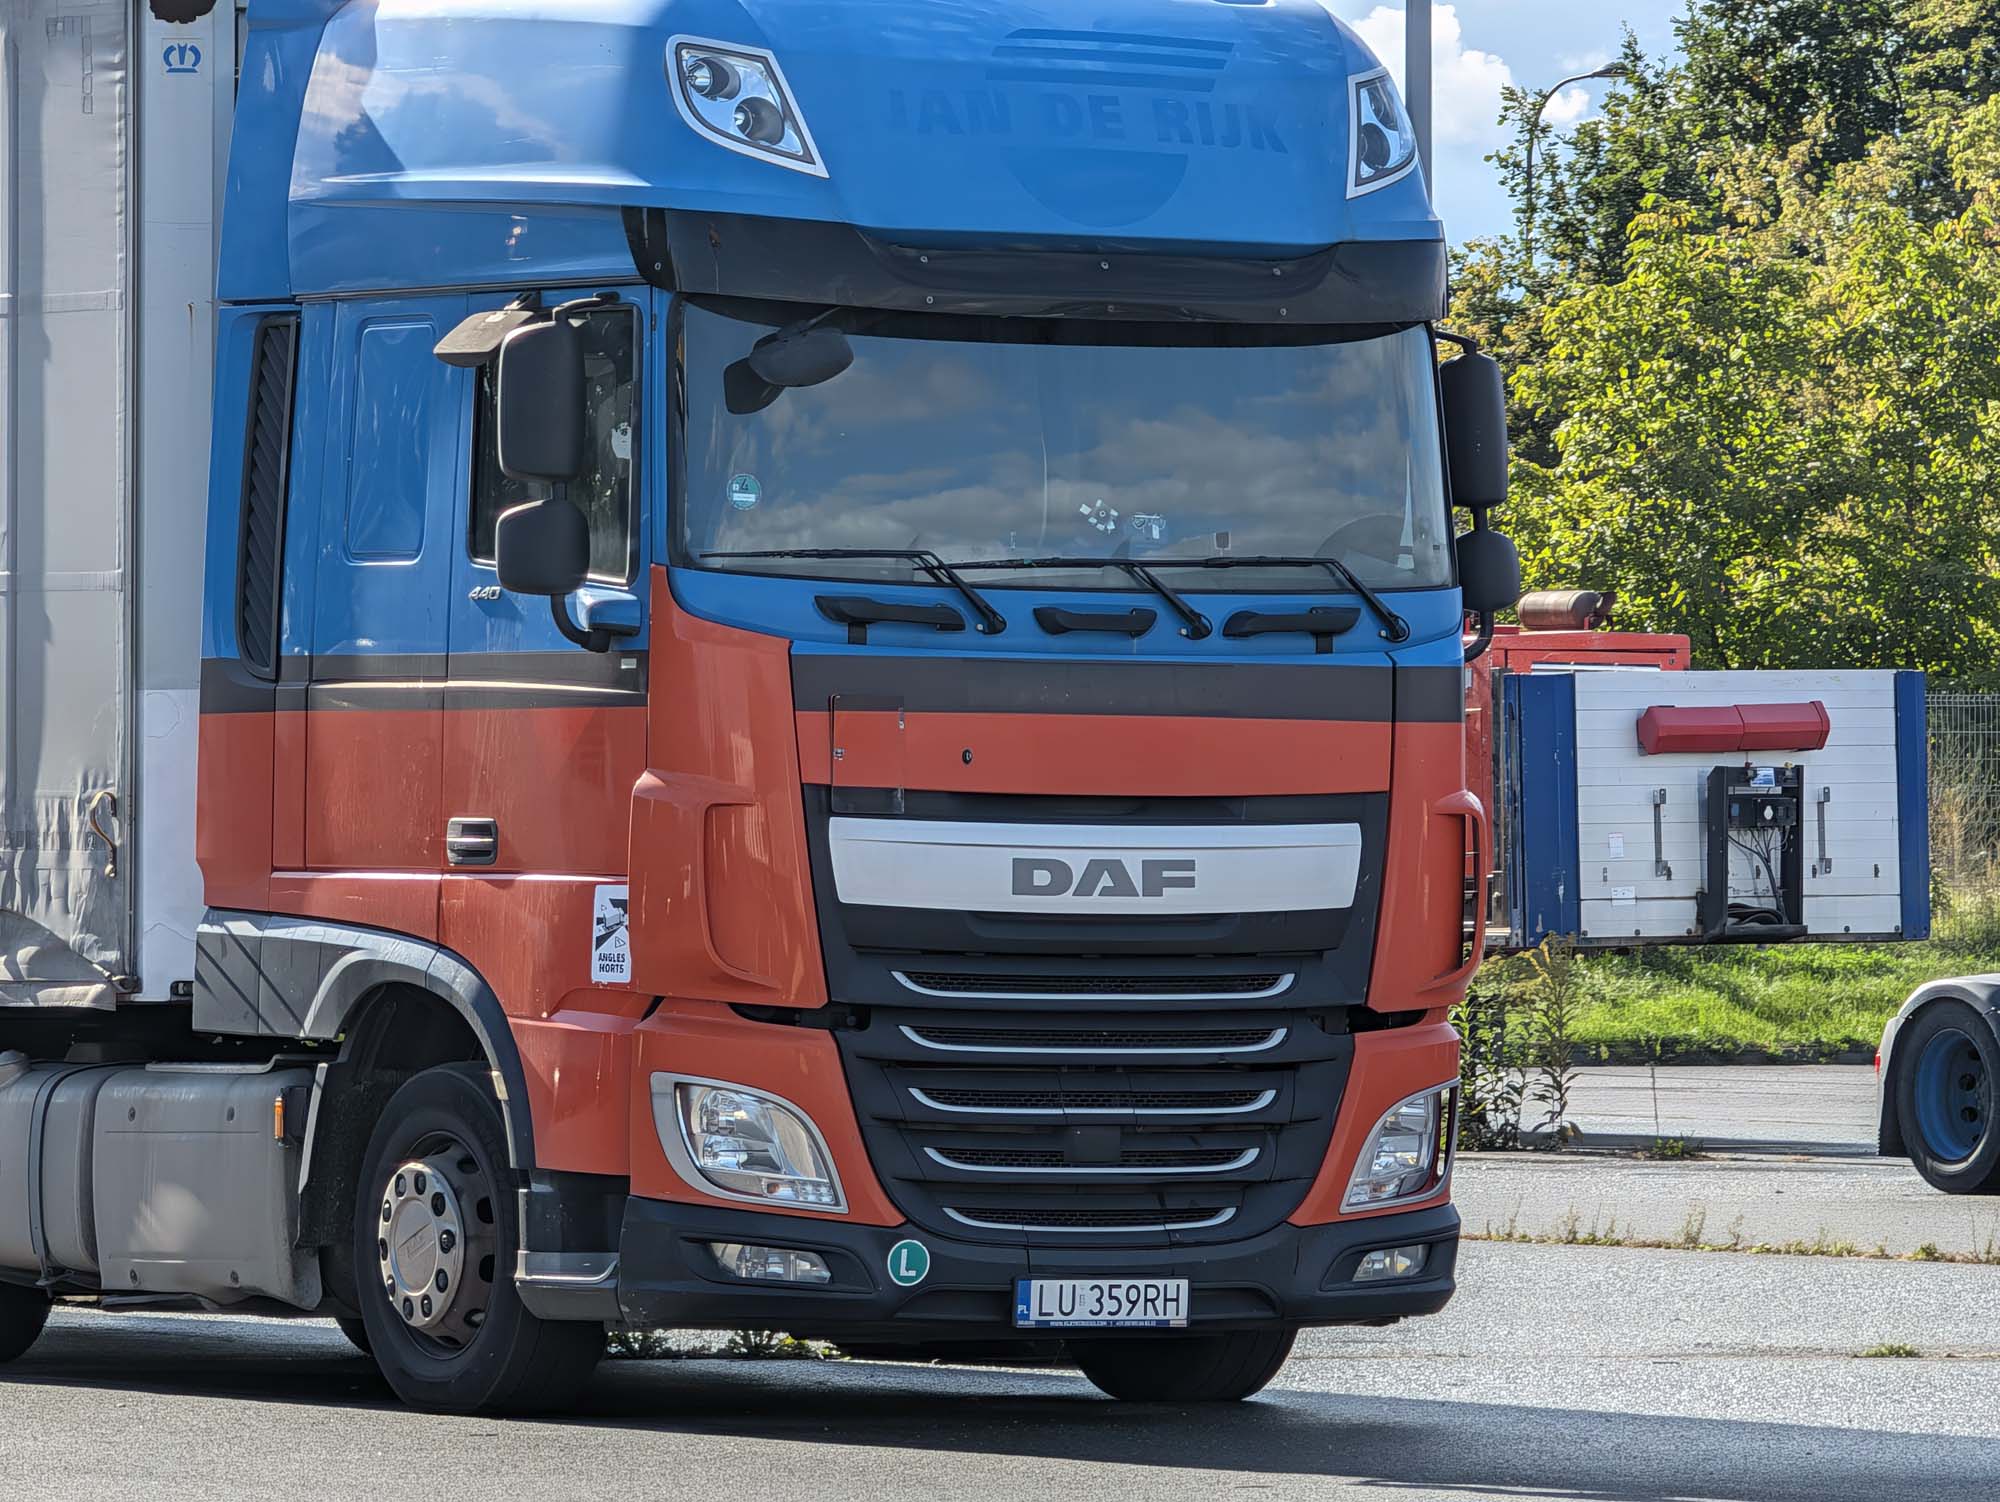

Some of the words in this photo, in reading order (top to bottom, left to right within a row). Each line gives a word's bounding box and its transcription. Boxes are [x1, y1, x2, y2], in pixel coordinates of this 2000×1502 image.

[1042, 92, 1127, 141] DE
[1151, 98, 1289, 154] RIJK
[468, 585, 501, 600] 440
[1012, 857, 1196, 897] DAF
[598, 953, 626, 963] ANGLES
[900, 1248, 917, 1277] L
[1017, 1304, 1030, 1315] PL
[1038, 1284, 1076, 1317] LU
[1088, 1284, 1181, 1317] 359RH
